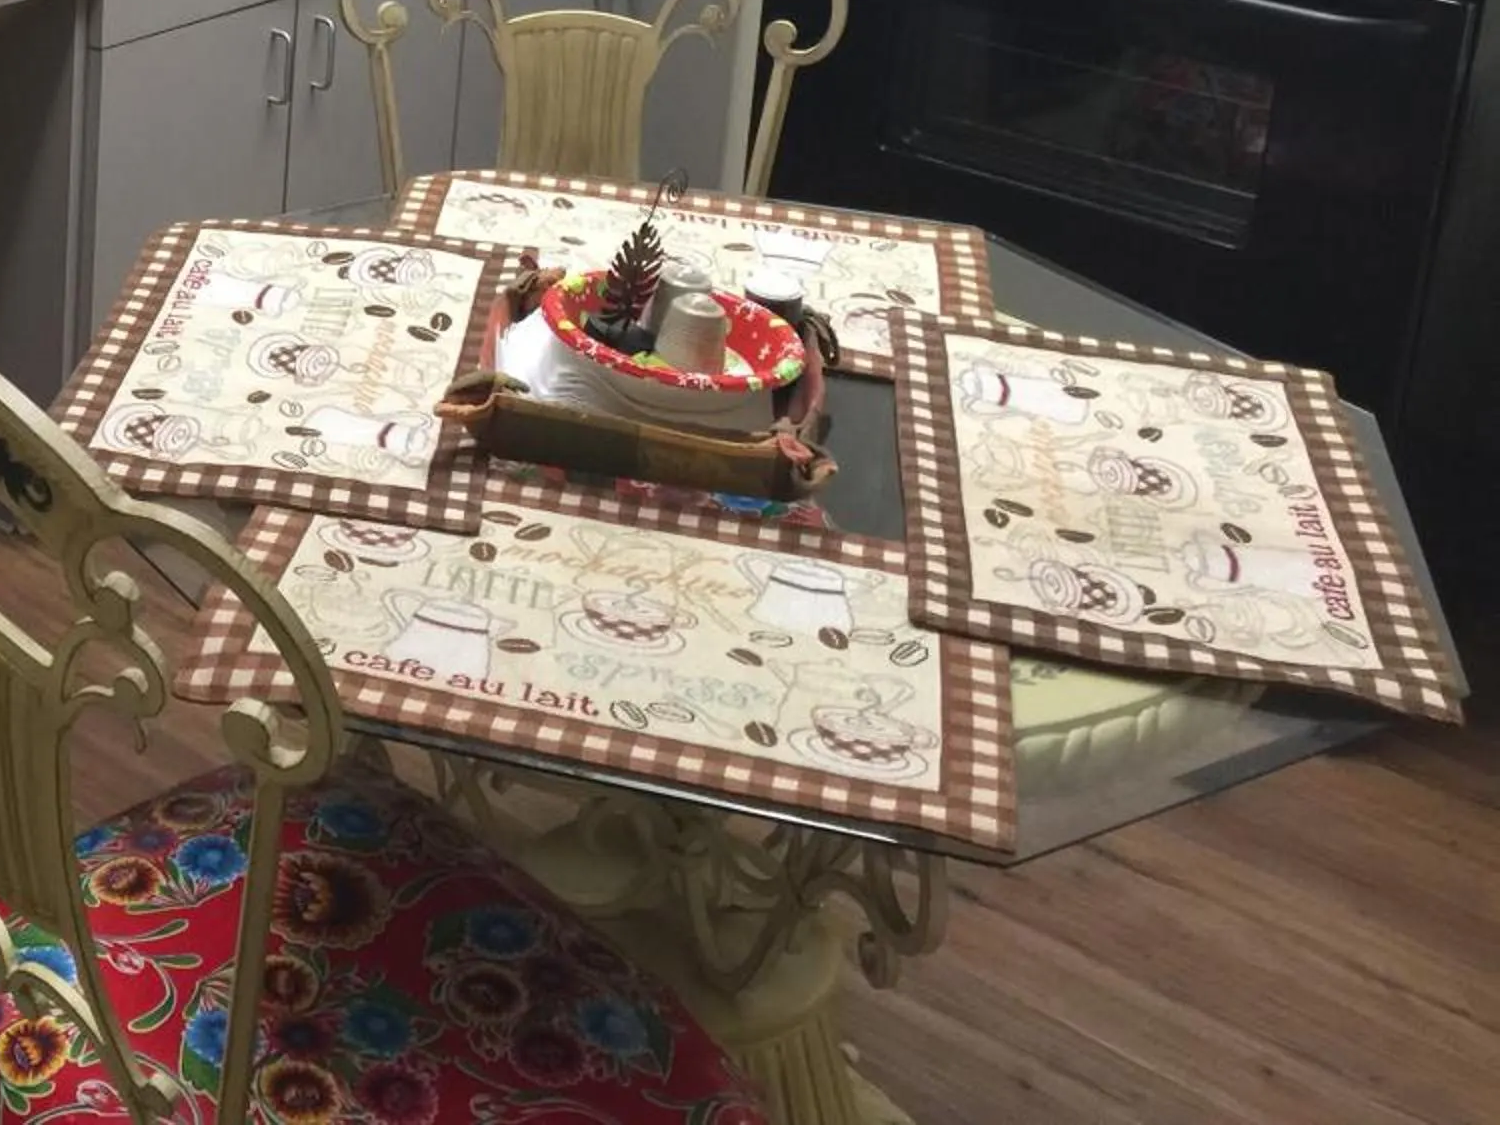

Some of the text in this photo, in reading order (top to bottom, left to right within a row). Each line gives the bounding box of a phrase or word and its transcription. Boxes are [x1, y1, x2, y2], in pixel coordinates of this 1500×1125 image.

[1288, 502, 1355, 621] cafe au lait
[344, 648, 601, 717] cafe au lait
